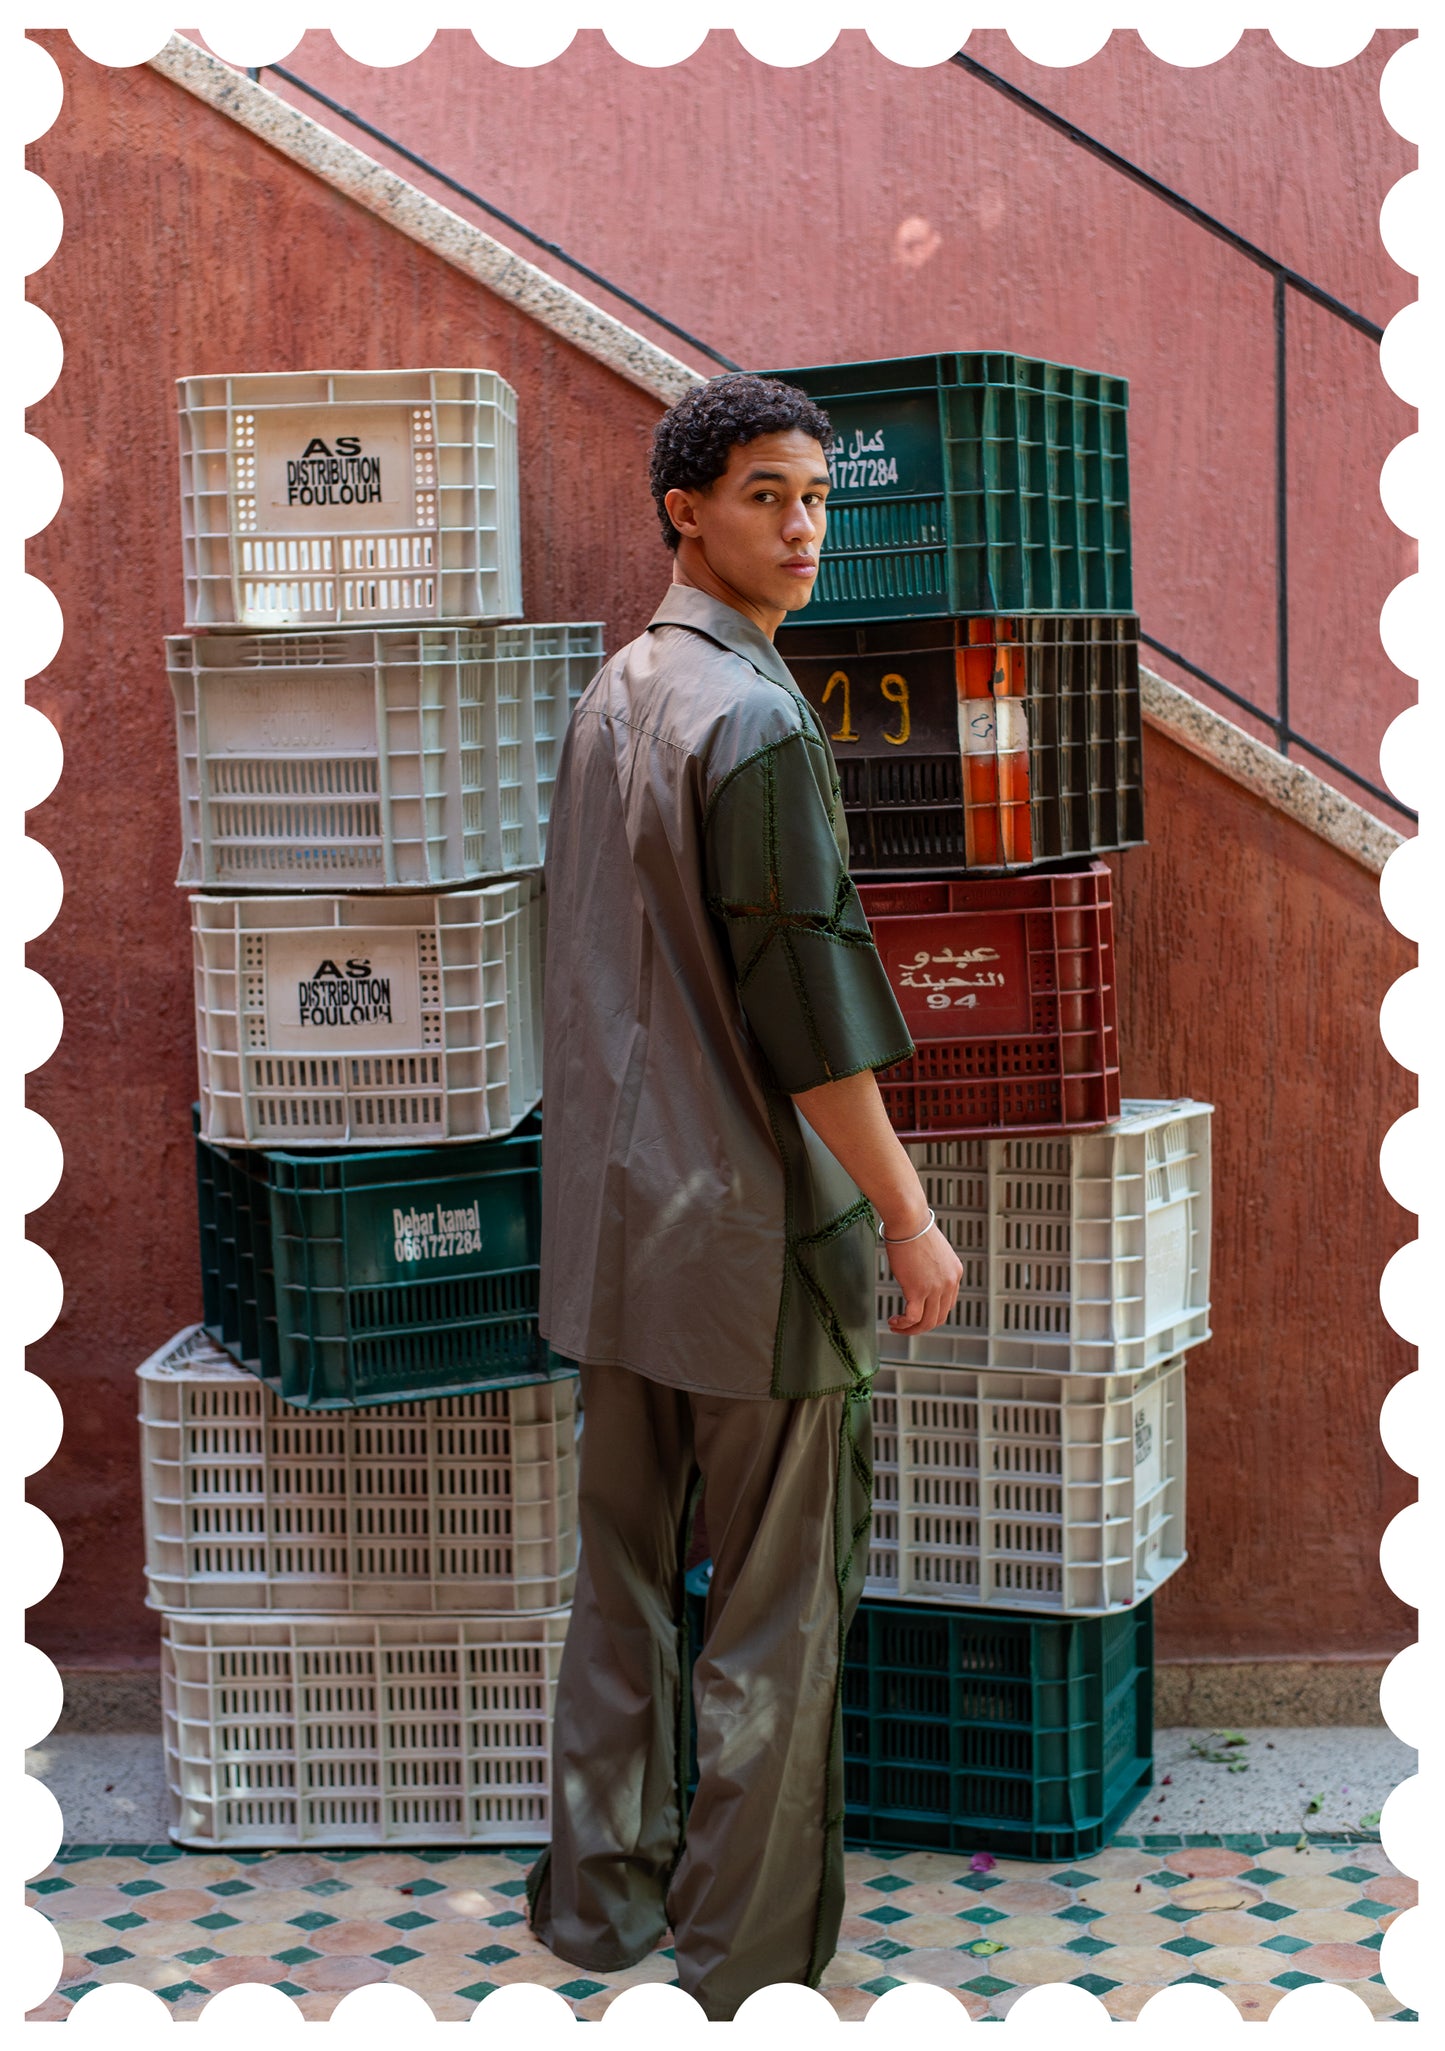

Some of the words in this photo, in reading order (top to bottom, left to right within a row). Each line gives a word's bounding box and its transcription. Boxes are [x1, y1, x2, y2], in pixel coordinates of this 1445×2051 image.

[302, 437, 362, 458] AS
[849, 429, 885, 459] كمال
[287, 457, 380, 486] DISTRIBUTION
[829, 457, 898, 489] 1727284
[288, 484, 382, 506] FOULOUH
[822, 670, 911, 746] 19
[313, 958, 372, 979] AS
[898, 947, 1000, 970] عبدو
[299, 978, 390, 1007] DISTRIBUTION
[926, 993, 979, 1009] 94
[300, 1005, 392, 1027] FOULOUH
[393, 1206, 435, 1238] Debar
[436, 1199, 480, 1233] kamal
[394, 1230, 482, 1262] 0661727284
